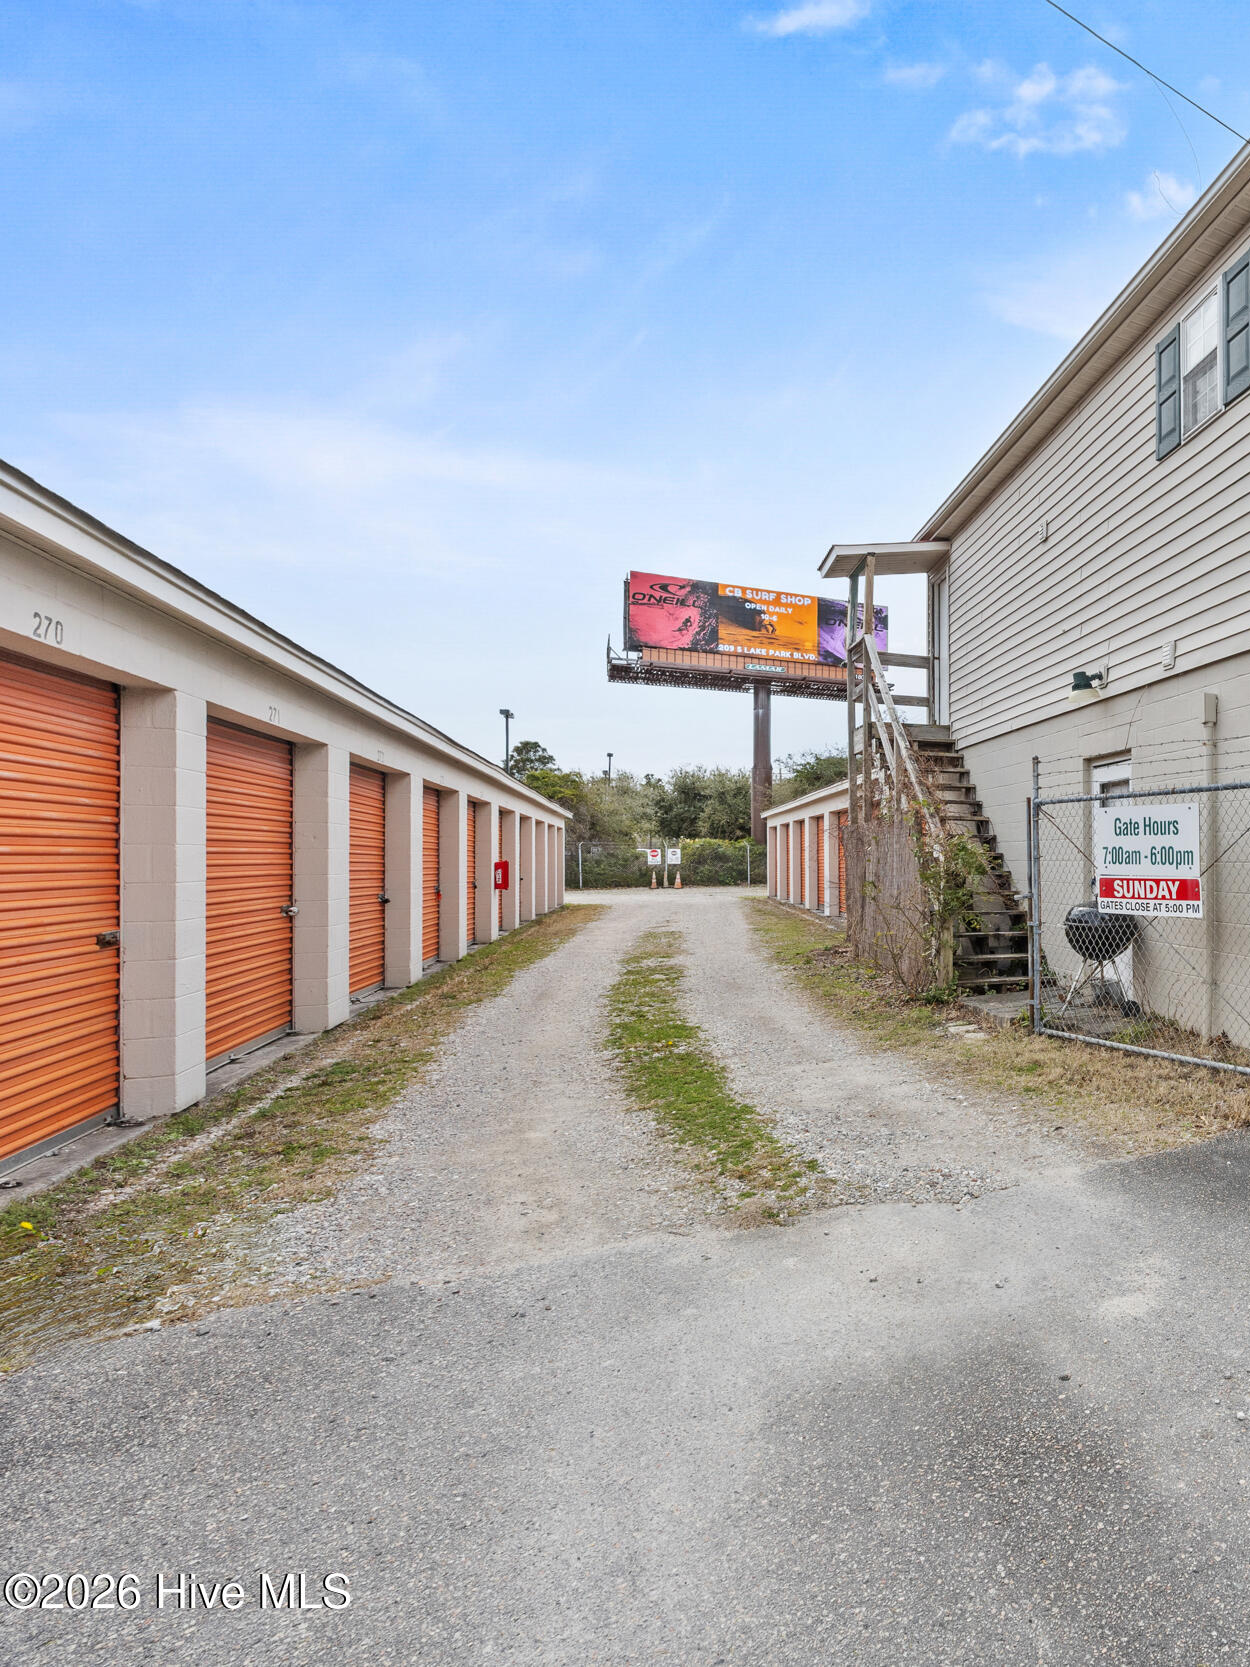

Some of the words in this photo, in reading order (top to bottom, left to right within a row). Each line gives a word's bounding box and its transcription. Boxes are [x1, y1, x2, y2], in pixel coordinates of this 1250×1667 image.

[725, 587, 742, 597] CB
[746, 589, 777, 601] SURF
[780, 594, 811, 606] SHOP
[745, 602, 767, 611] OPEN
[769, 605, 793, 614] DAILY
[33, 611, 63, 645] 270
[717, 644, 735, 652] 209
[744, 646, 767, 655] LAKE
[769, 649, 791, 658] PARK
[793, 651, 818, 661] BLVD.
[1114, 817, 1140, 836] Gate
[1143, 816, 1179, 836] Hours
[1102, 846, 1141, 865] 7:00am
[1150, 846, 1194, 870] 6:00pm
[1113, 880, 1180, 899] SUNDAY
[1100, 900, 1123, 911] GATES
[1125, 901, 1150, 912] CLOSE
[1153, 902, 1163, 912] AT
[1165, 903, 1183, 913] 5:00
[1186, 903, 1200, 913] PM
